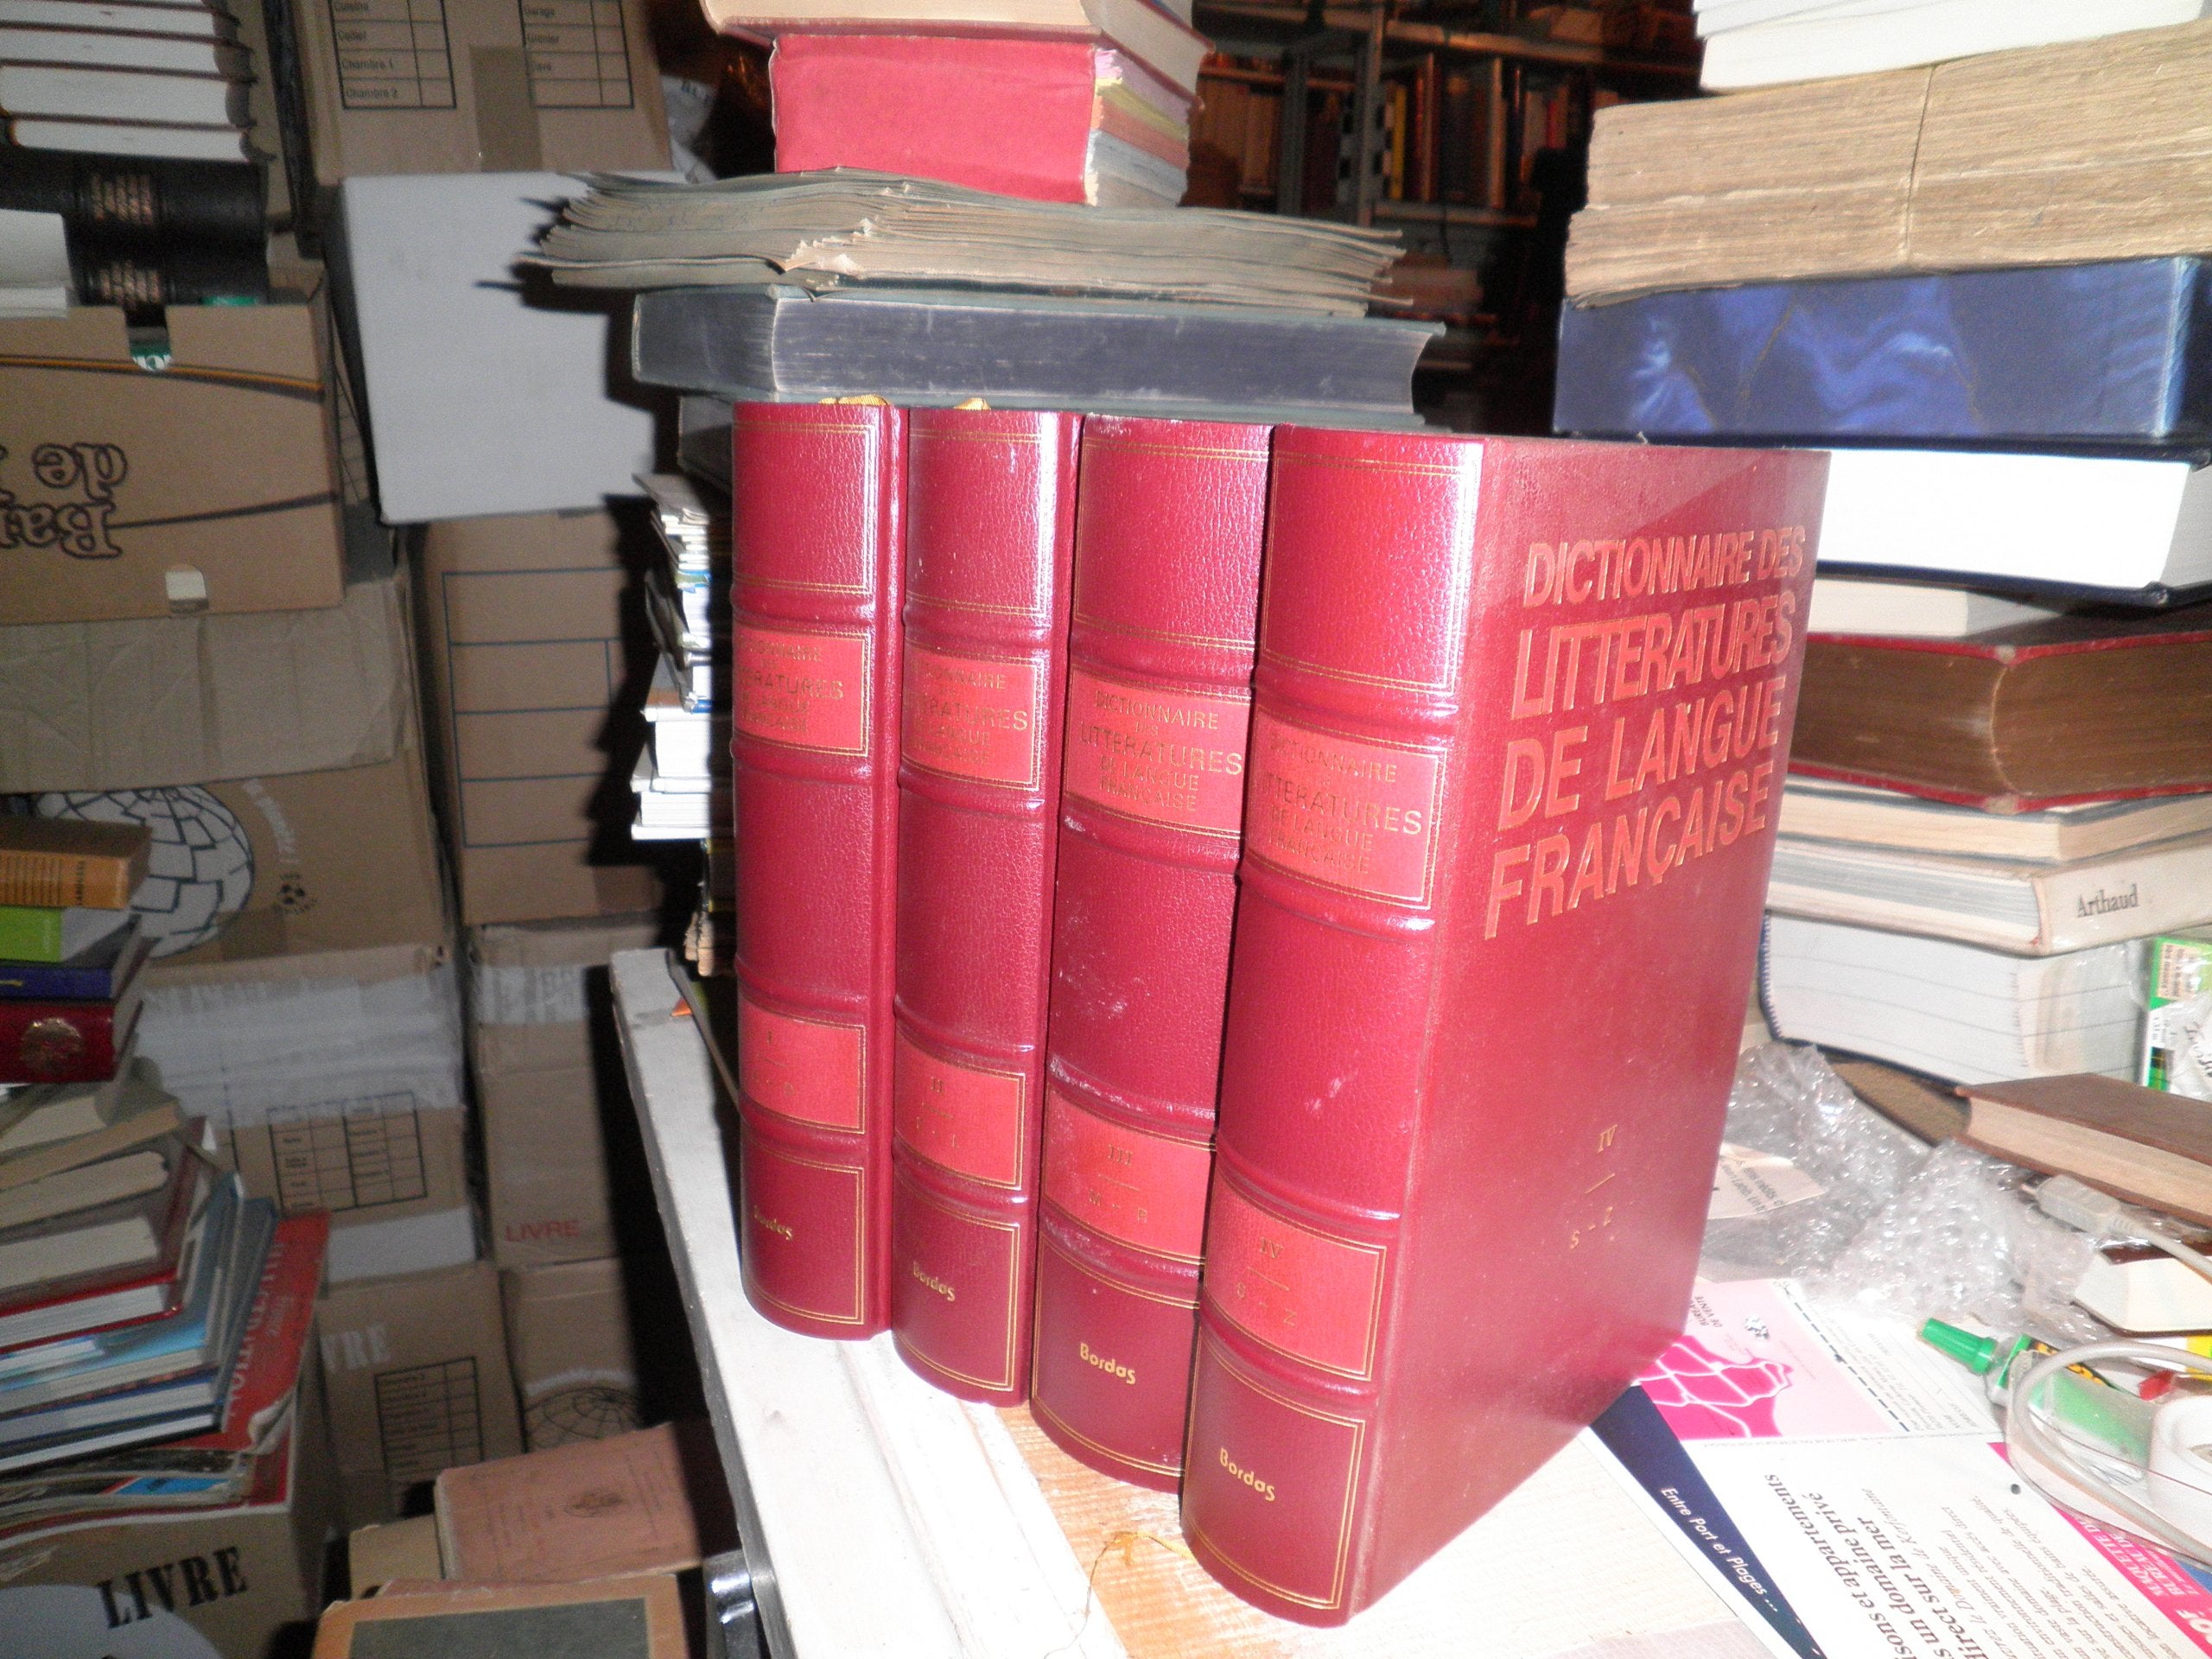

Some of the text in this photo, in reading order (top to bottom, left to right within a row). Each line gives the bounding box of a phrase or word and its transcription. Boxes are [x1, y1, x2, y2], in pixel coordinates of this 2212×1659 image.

[1523, 526, 1805, 607] DICTIONNAIRE DES
[1512, 590, 1796, 720] LITTERATURES
[1095, 690, 1219, 730] DICTIONNAIRE
[1080, 721, 1243, 775] LITTERATURES
[1497, 677, 1785, 830] DE LANGUE
[1123, 761, 1199, 791] LANGUE
[1294, 815, 1374, 852] LANGUE
[1485, 762, 1773, 939] FRANÇAISE
[2075, 883, 2139, 918] Arthaud
[1108, 1143, 1134, 1167] III
[1597, 1124, 1619, 1154] IV
[505, 1218, 581, 1244] LIVRE
[1260, 1236, 1284, 1261] IV
[1236, 1281, 1247, 1300] S
[1283, 1308, 1297, 1328] Z
[1694, 1296, 1714, 1317] VENTE
[1079, 1342, 1137, 1388] Bordas
[1218, 1446, 1276, 1503] Bordas
[1764, 1474, 1859, 1588] appartements
[1802, 1491, 1858, 1535] privé
[1942, 1506, 1968, 1529] direct
[1661, 1488, 1691, 1516] Entre
[1689, 1518, 1719, 1541] Port
[1713, 1543, 1732, 1555] et
[1726, 1557, 1767, 1596] Plages
[1858, 1516, 1895, 1551] mer
[1889, 1554, 1911, 1571] la
[1914, 1548, 1930, 1561] de
[1938, 1546, 1971, 1577] unique
[1987, 1554, 2011, 1574] avec
[2012, 1537, 2073, 1598] traditionnelle
[2039, 1546, 2066, 1570] bains
[2095, 1534, 2166, 1597] MAQUETTE
[2130, 1548, 2185, 1596] BUREAU
[96, 1546, 248, 1630] LIVRE
[1845, 1538, 1915, 1615] domaine
[1904, 1573, 1941, 1605] sur
[1927, 1563, 1975, 1611] Domaine
[2065, 1571, 2080, 1583] de
[1851, 1589, 1875, 1610] et
[1967, 1578, 2007, 1619] vraiment
[1985, 1573, 2054, 1646] environnement
[2007, 1577, 2048, 1619] domaine
[2078, 1584, 2106, 1611] salles
[1910, 1618, 1940, 1645] un
[2047, 1619, 2074, 1643] vaste
[2077, 1628, 2097, 1647] sur
[2118, 1602, 2160, 1640] locative
